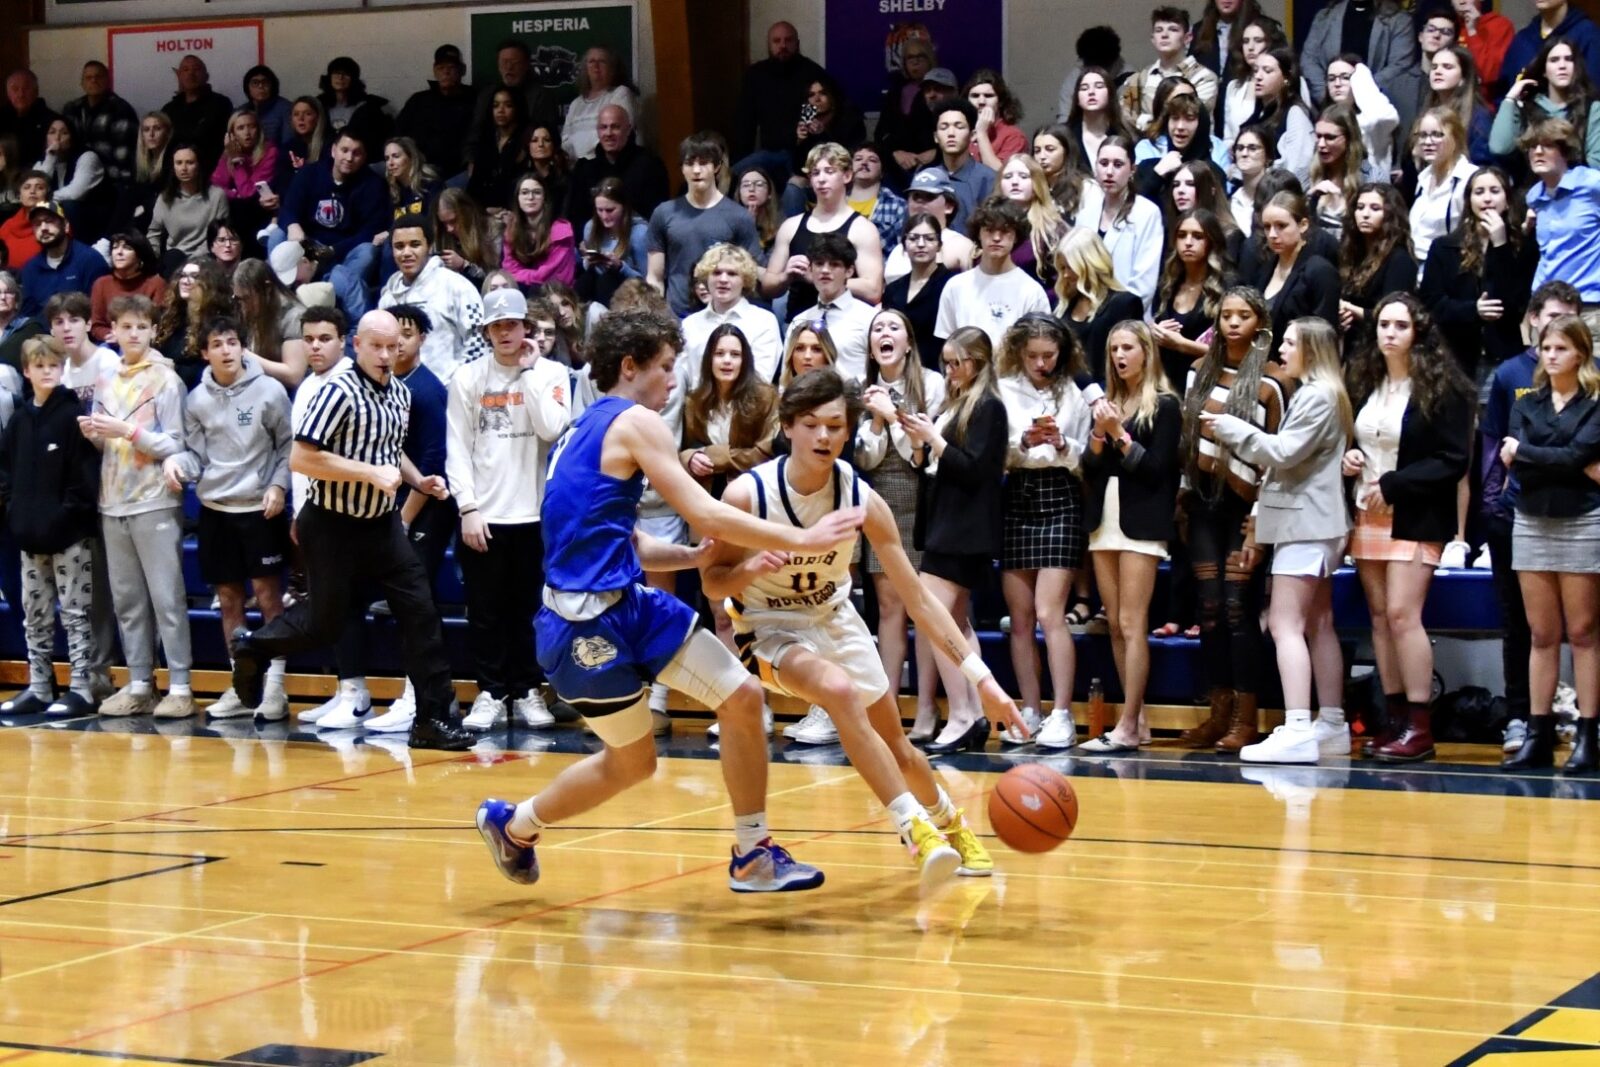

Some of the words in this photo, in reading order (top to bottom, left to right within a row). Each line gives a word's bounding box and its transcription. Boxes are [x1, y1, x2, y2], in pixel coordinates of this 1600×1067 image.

[879, 0, 945, 13] SHELBY
[512, 18, 590, 33] HESPERIA
[156, 38, 213, 52] HOLTON
[790, 571, 818, 593] 11
